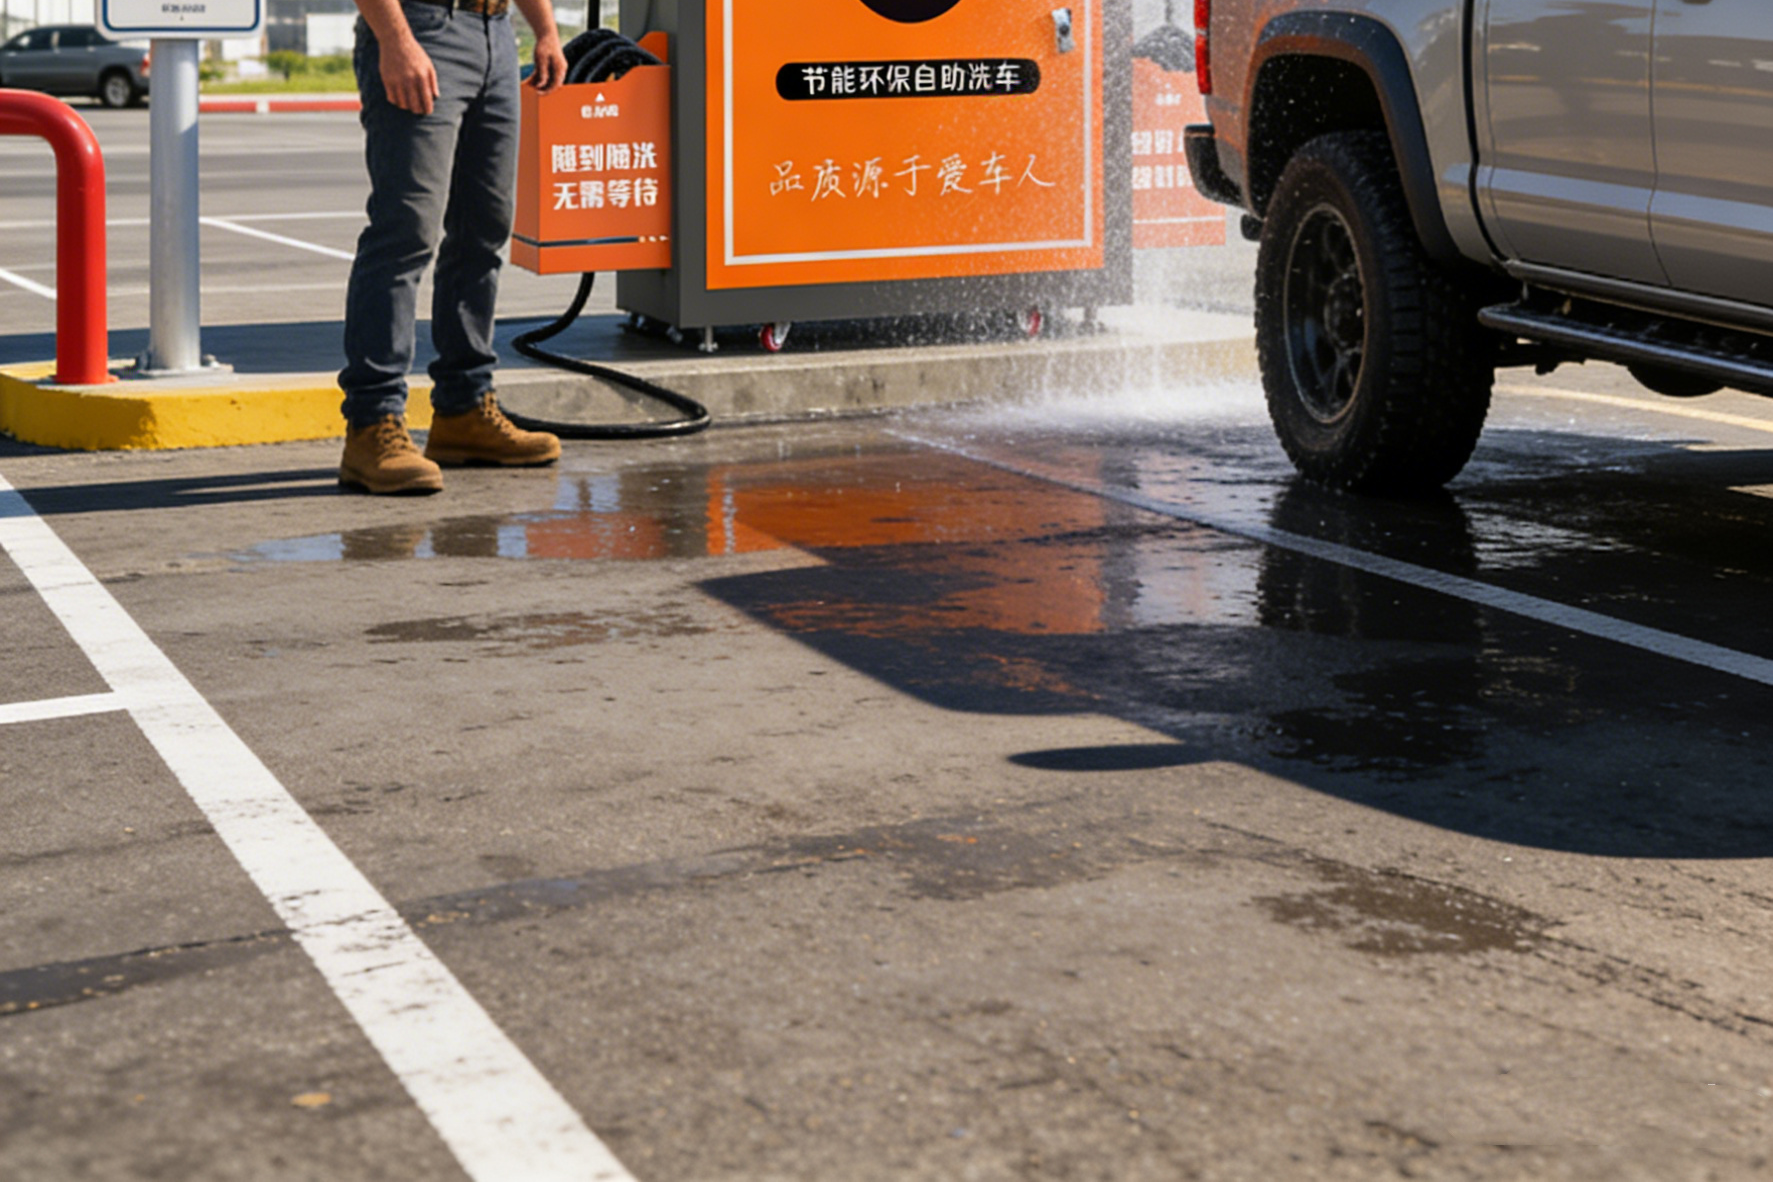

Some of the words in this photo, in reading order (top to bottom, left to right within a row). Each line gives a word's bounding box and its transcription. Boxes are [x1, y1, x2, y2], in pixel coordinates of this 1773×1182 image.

[801, 62, 1021, 96] 节能环保自助洗车
[769, 151, 1056, 202] 品质源于爱车人
